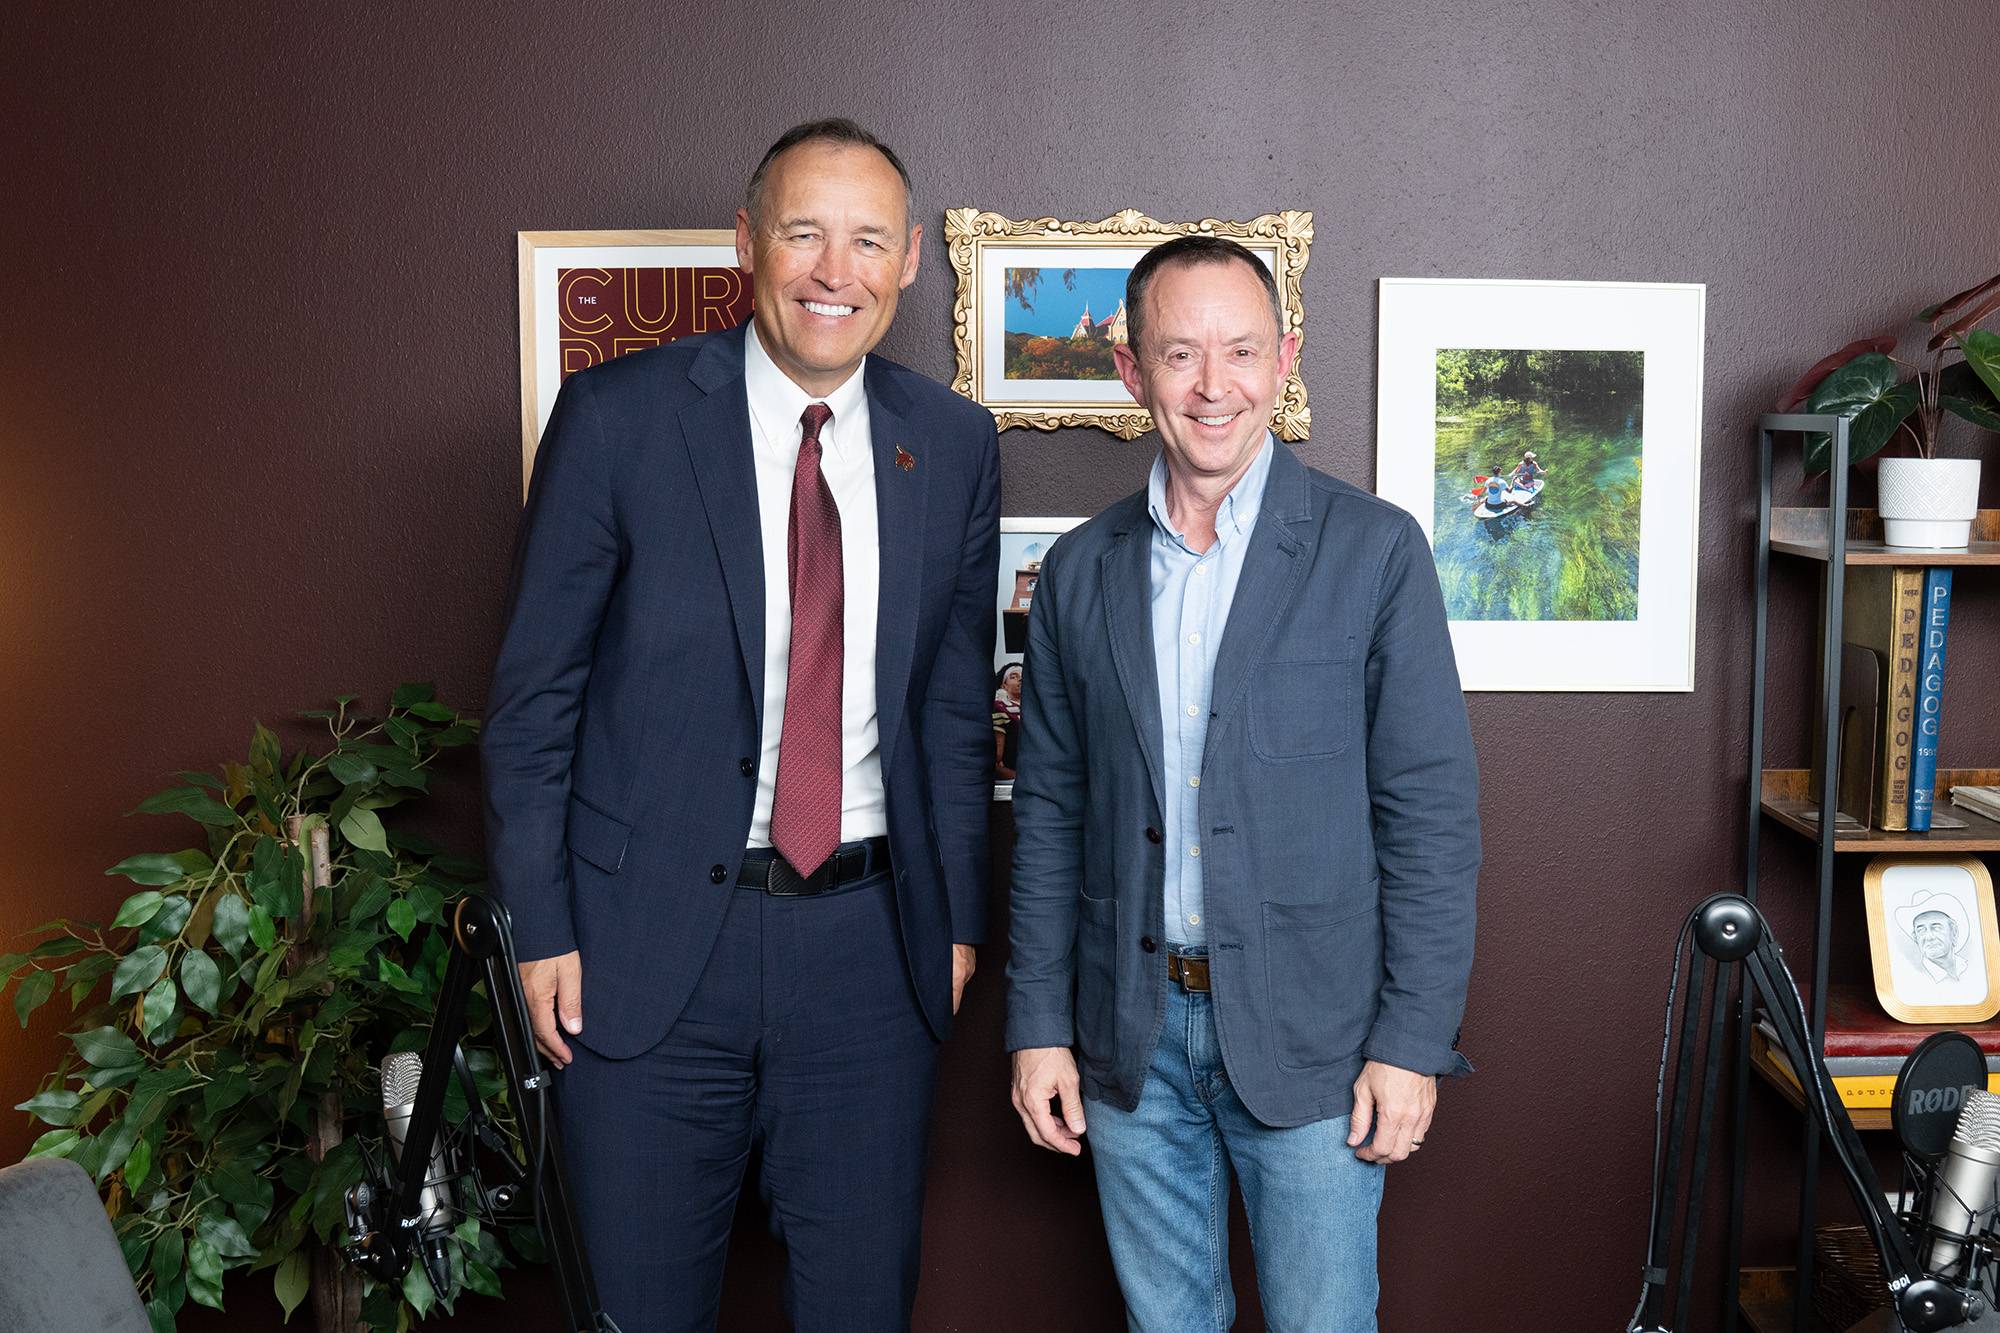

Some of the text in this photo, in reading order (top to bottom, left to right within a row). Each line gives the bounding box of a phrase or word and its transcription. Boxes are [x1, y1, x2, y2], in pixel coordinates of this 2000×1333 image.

[557, 266, 755, 334] CUR
[578, 296, 597, 305] THE
[1895, 608, 1916, 770] PEDAGOG
[1922, 586, 1947, 735] PEDAGOG
